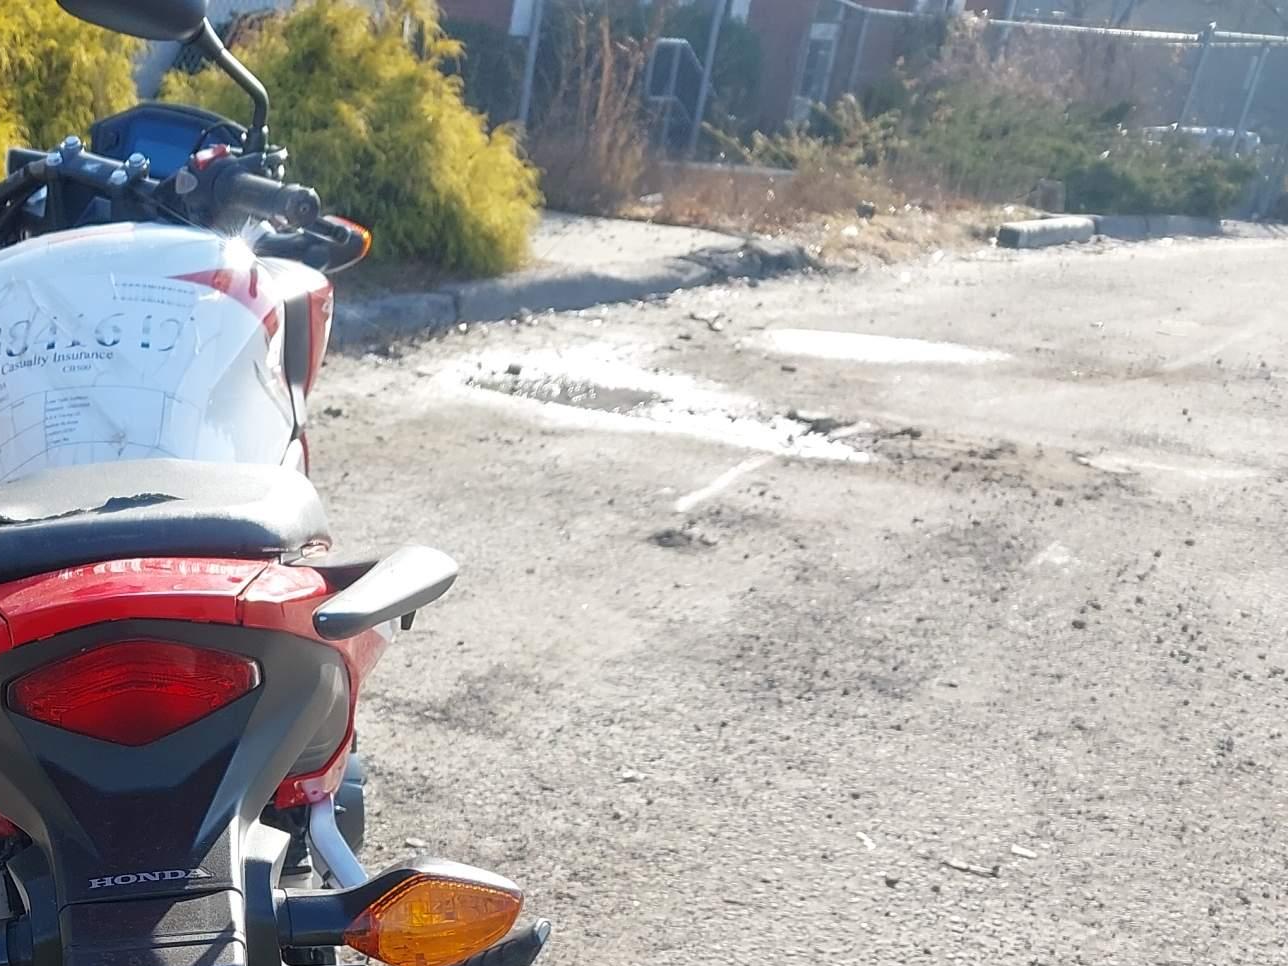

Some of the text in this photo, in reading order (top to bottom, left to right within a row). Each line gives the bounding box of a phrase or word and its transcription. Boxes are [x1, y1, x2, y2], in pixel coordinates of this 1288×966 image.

[1, 354, 48, 375] Casualty
[52, 350, 114, 363] Insurance
[88, 868, 214, 889] HONDA
